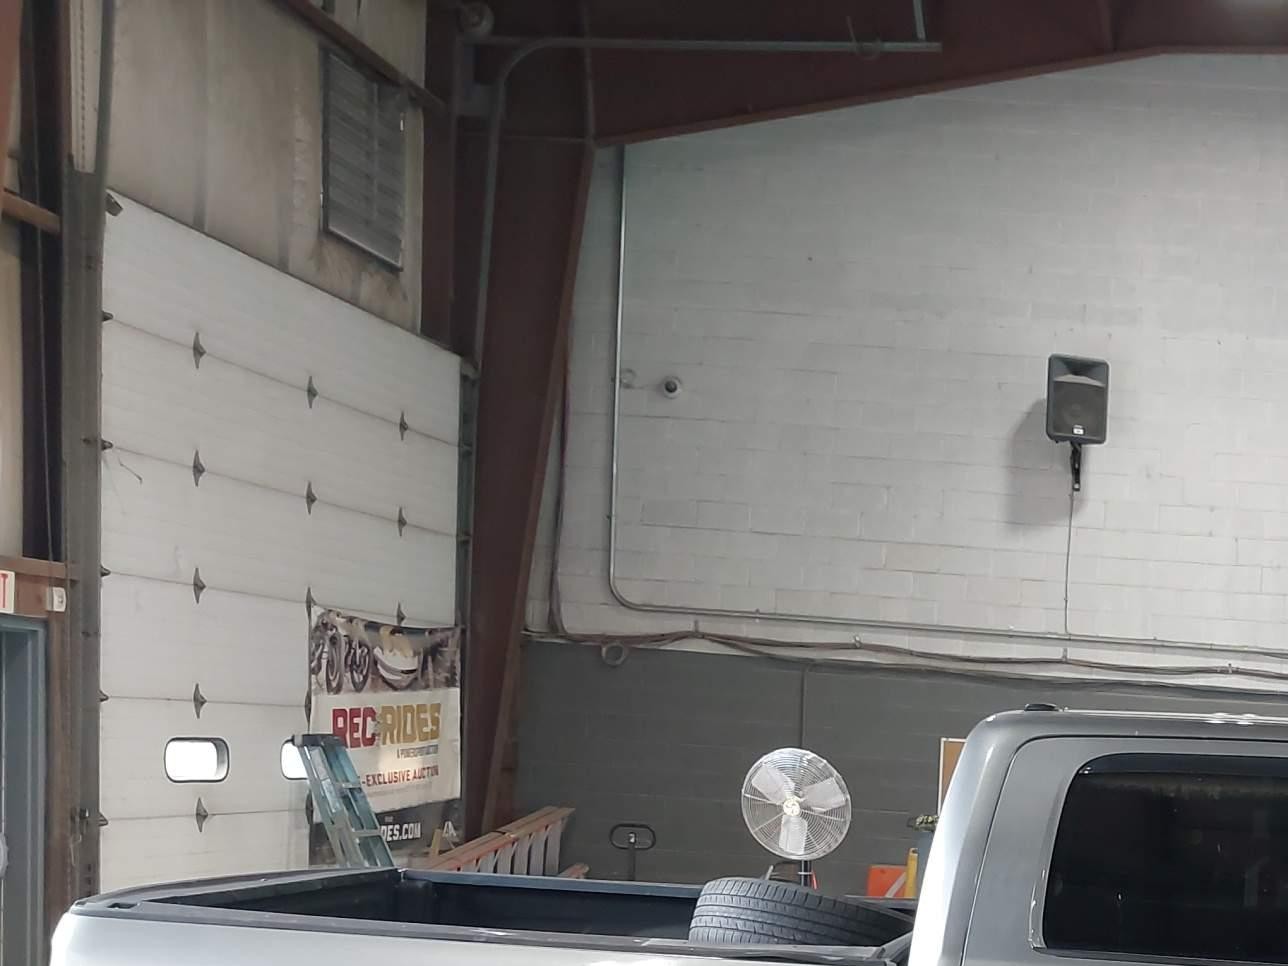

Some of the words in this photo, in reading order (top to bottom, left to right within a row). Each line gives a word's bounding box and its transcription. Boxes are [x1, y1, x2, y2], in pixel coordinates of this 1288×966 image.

[381, 703, 441, 745] RIDES
[362, 769, 411, 787] -EXCLUSIVE
[380, 822, 421, 841] DES.COM
